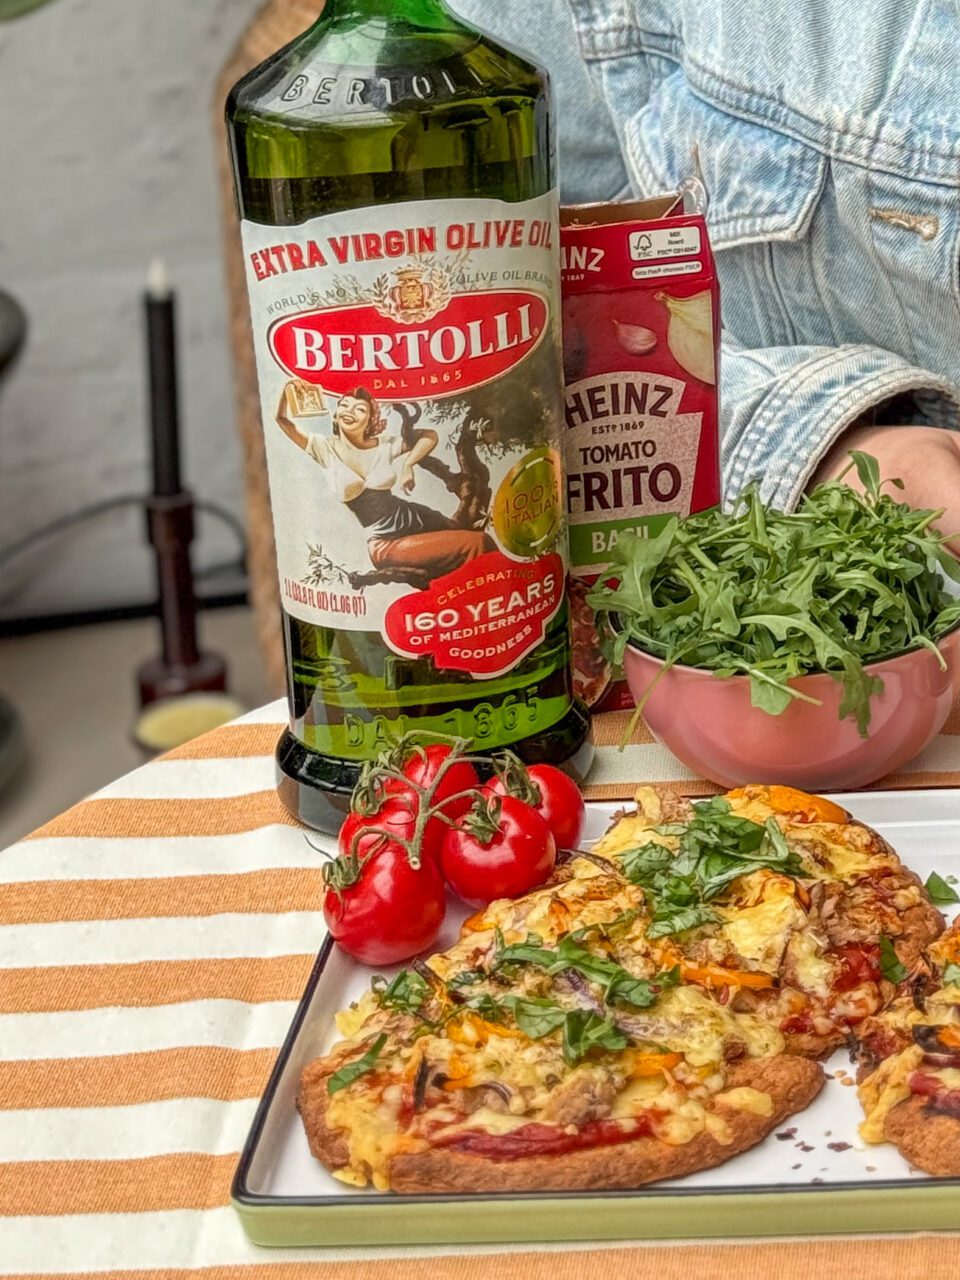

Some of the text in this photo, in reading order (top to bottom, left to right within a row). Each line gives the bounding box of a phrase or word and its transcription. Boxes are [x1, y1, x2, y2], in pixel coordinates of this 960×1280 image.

[250, 220, 552, 282] EXTRA VIRGIN OLIVE OIL
[561, 246, 605, 272] INZ
[456, 271, 498, 284] OLIVE
[502, 270, 522, 281] OIL
[266, 291, 320, 315] WORLD'S
[291, 304, 535, 373] BERTOLLI
[373, 370, 463, 391] DAL 1865
[564, 382, 674, 429] HEINZ
[621, 421, 645, 432] 1869
[579, 439, 657, 466] TOMATO
[566, 462, 682, 514] FRITO
[505, 491, 559, 529] ITALIAN
[329, 591, 351, 615] (1.06
[352, 594, 367, 618] QT)
[404, 573, 555, 633] 160 YEARS
[436, 569, 535, 606] CELEBRATING
[409, 595, 555, 646] OF MEDITERRANEAN
[449, 624, 532, 659] GOODNESS
